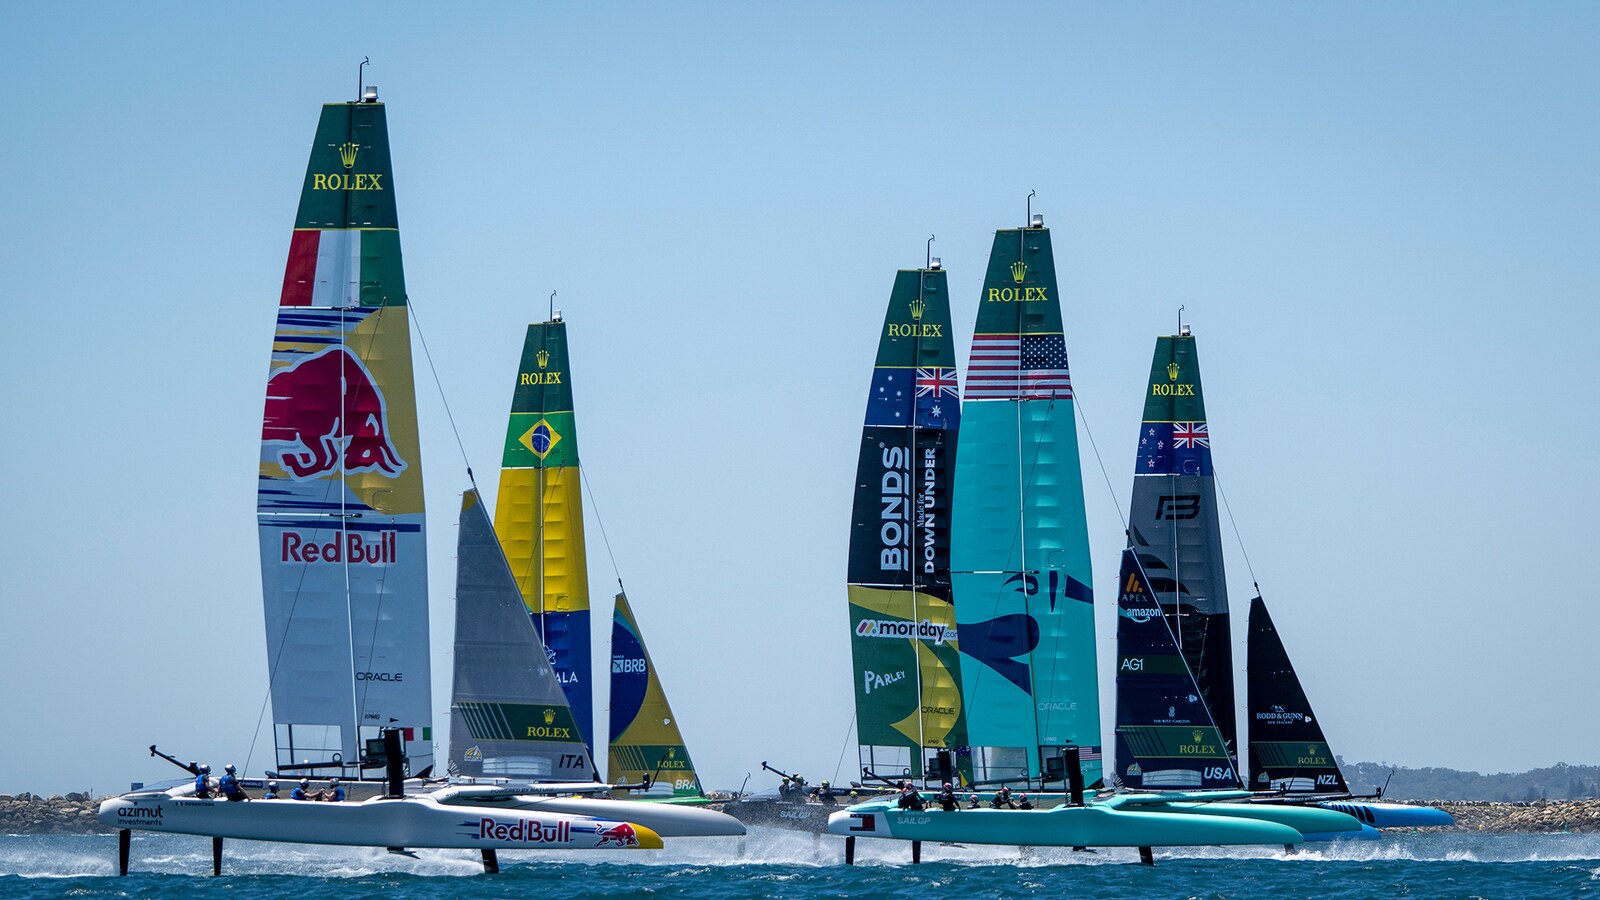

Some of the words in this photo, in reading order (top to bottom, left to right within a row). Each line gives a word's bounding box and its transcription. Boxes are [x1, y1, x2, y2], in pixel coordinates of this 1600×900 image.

[313, 174, 383, 190] ROLEX
[988, 287, 1048, 302] ROLEX
[888, 323, 943, 338] ROLEX
[520, 372, 562, 385] ROLEX
[1152, 384, 1194, 396] ROLEX
[924, 448, 936, 508] UNDER
[916, 493, 924, 504] for
[880, 446, 903, 570] BONDS
[916, 506, 924, 528] Made
[924, 513, 936, 573] DOWN
[1122, 594, 1148, 602] APEX
[1126, 608, 1162, 617] amazon
[624, 658, 646, 673] BRB
[1121, 658, 1144, 670] AG1
[356, 672, 403, 682] ORACLE
[864, 670, 906, 694] PARLEY
[921, 706, 954, 714] ORACLE
[1037, 702, 1078, 710] ORACLE
[527, 726, 570, 738] ROLEX
[1180, 744, 1216, 754] ROLEX
[558, 754, 584, 769] ITA
[657, 760, 684, 768] ROLEX
[1204, 767, 1232, 780] USA
[1317, 774, 1338, 785] NZL
[674, 779, 696, 790] BRA
[117, 804, 163, 818] azimut
[118, 818, 162, 826] investments
